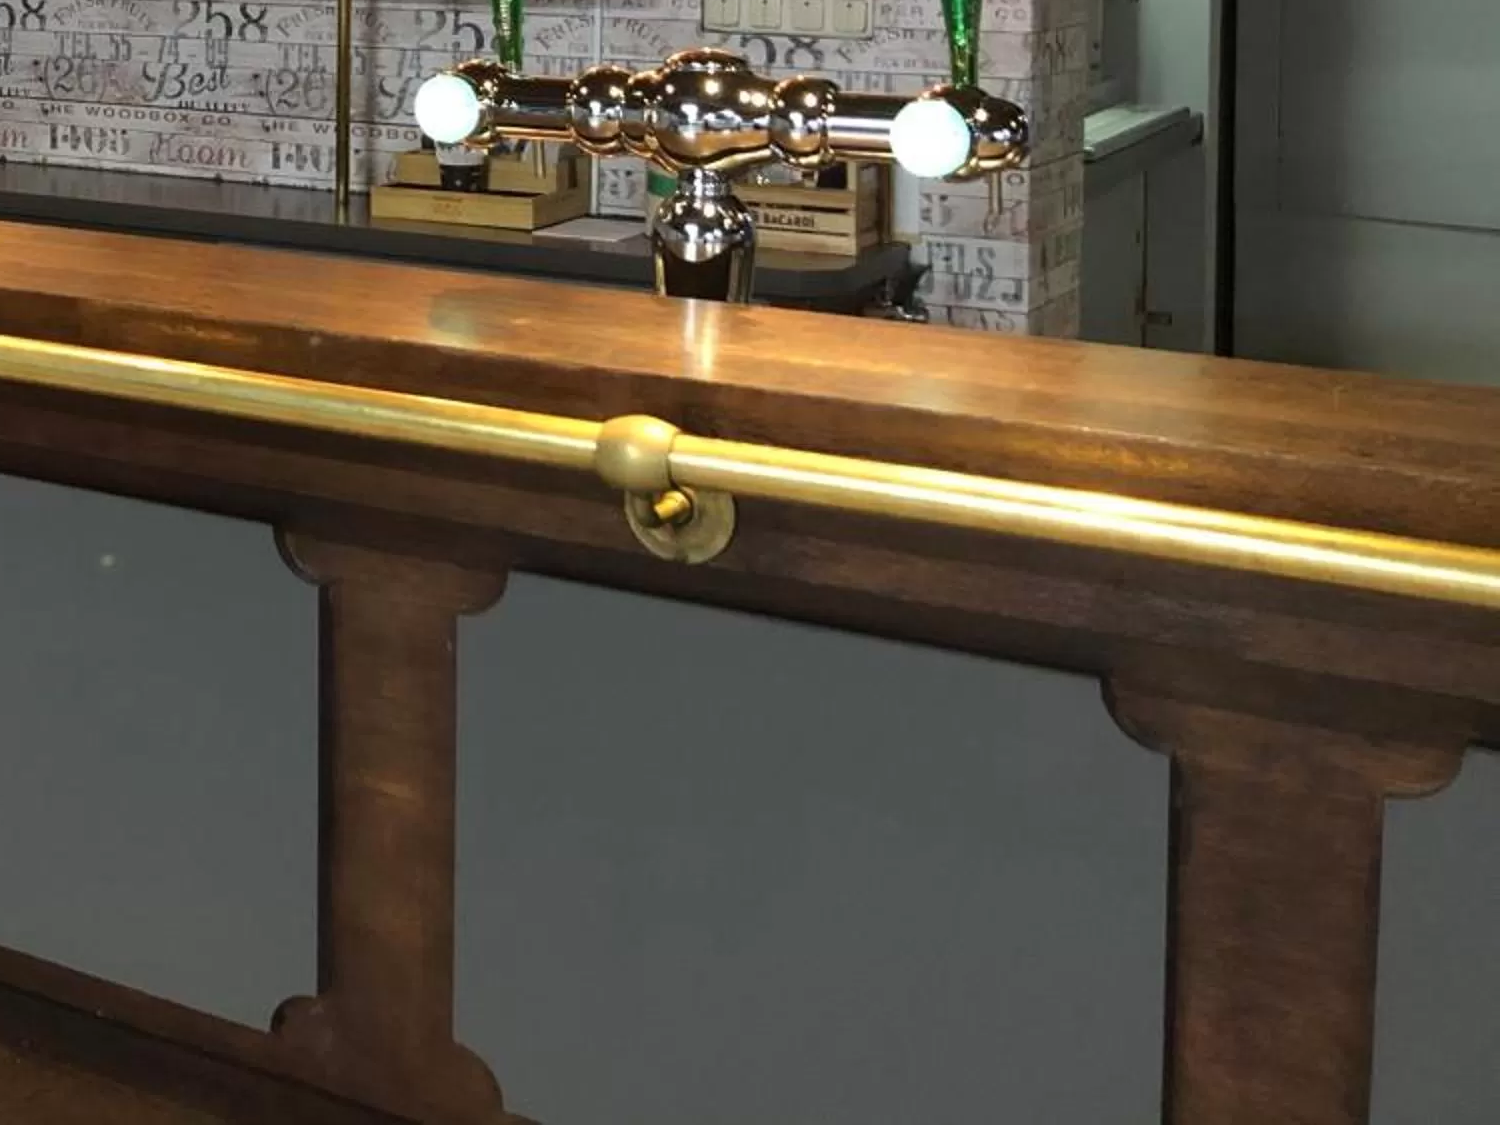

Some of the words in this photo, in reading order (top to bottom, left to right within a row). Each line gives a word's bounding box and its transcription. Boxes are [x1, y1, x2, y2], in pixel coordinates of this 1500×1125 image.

[172, 0, 269, 43] 258
[141, 62, 231, 103] Best
[84, 106, 190, 124] WOODBOX
